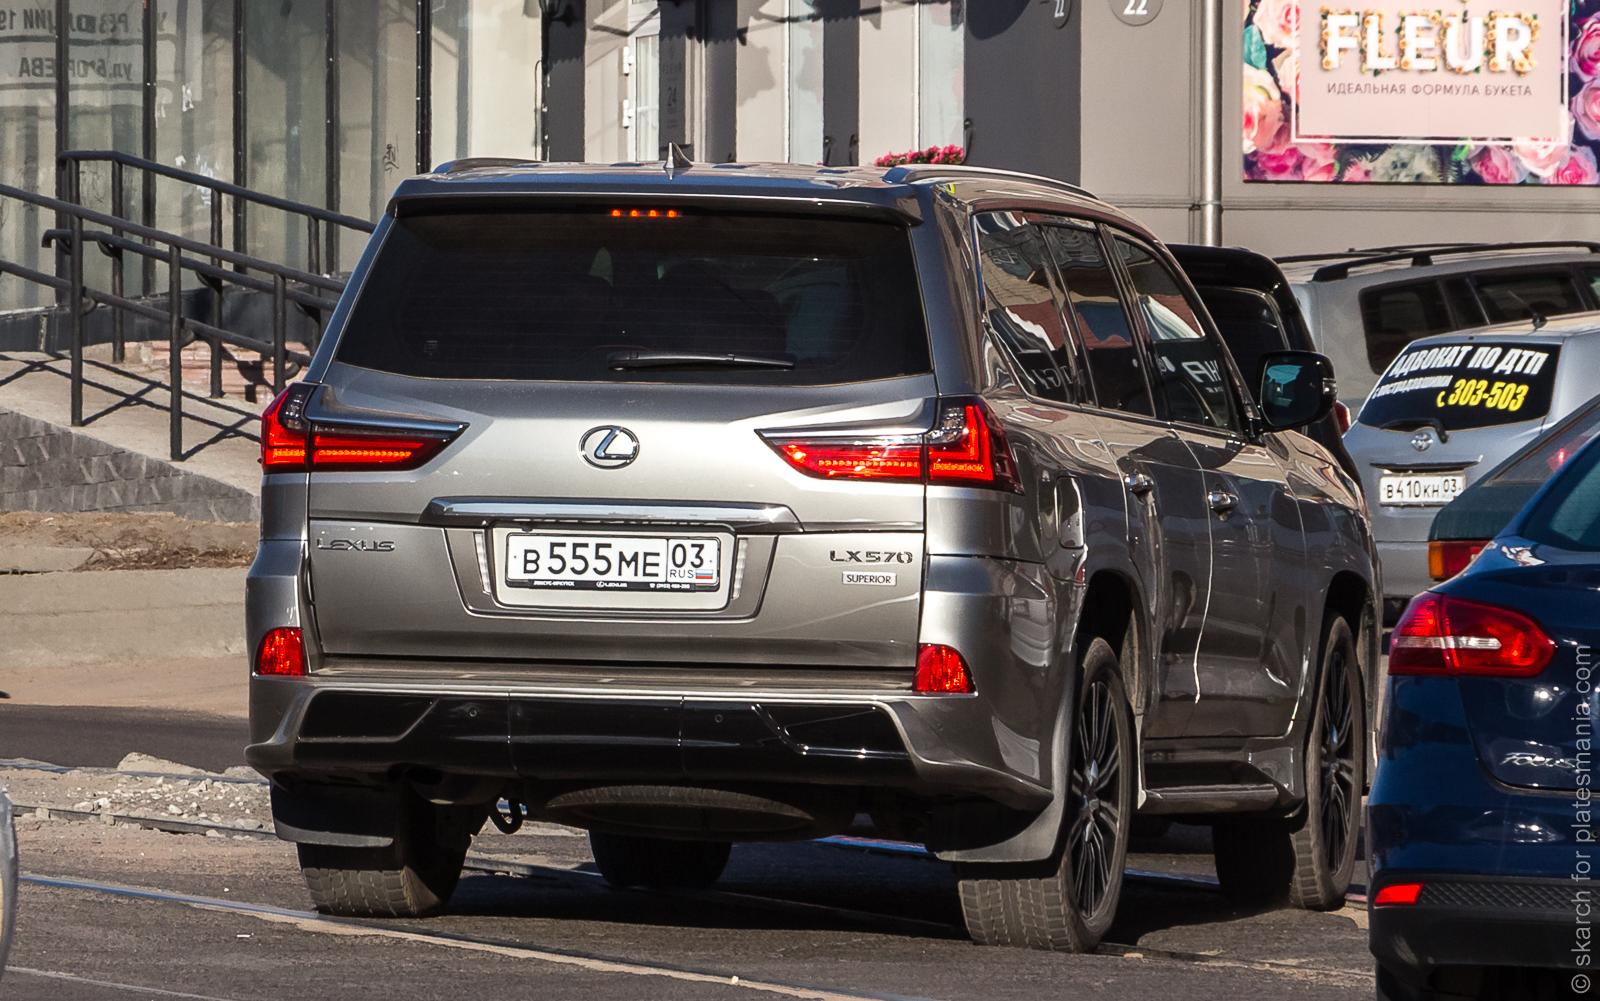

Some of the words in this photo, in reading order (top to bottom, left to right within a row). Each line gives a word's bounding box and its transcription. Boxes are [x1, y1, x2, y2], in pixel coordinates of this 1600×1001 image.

[1320, 8, 1541, 75] FLEUR
[1327, 83, 1406, 95] ИДЕАЛЬНАЯ
[1411, 84, 1480, 96] ФОРМУЛА
[1484, 85, 1533, 96] БУКЕТА
[1388, 346, 1473, 378] АДВОКАТ
[1467, 346, 1503, 369] ПО
[1493, 348, 1550, 375] ДТП
[1447, 378, 1530, 412] 303-503
[1386, 480, 1440, 498] В410КН
[1443, 479, 1458, 493] 03
[316, 538, 395, 552] LEXUS
[523, 542, 660, 577] В555МЕ
[672, 543, 705, 568] 03
[669, 569, 694, 579] RUS
[846, 574, 892, 584] SUPERIOR
